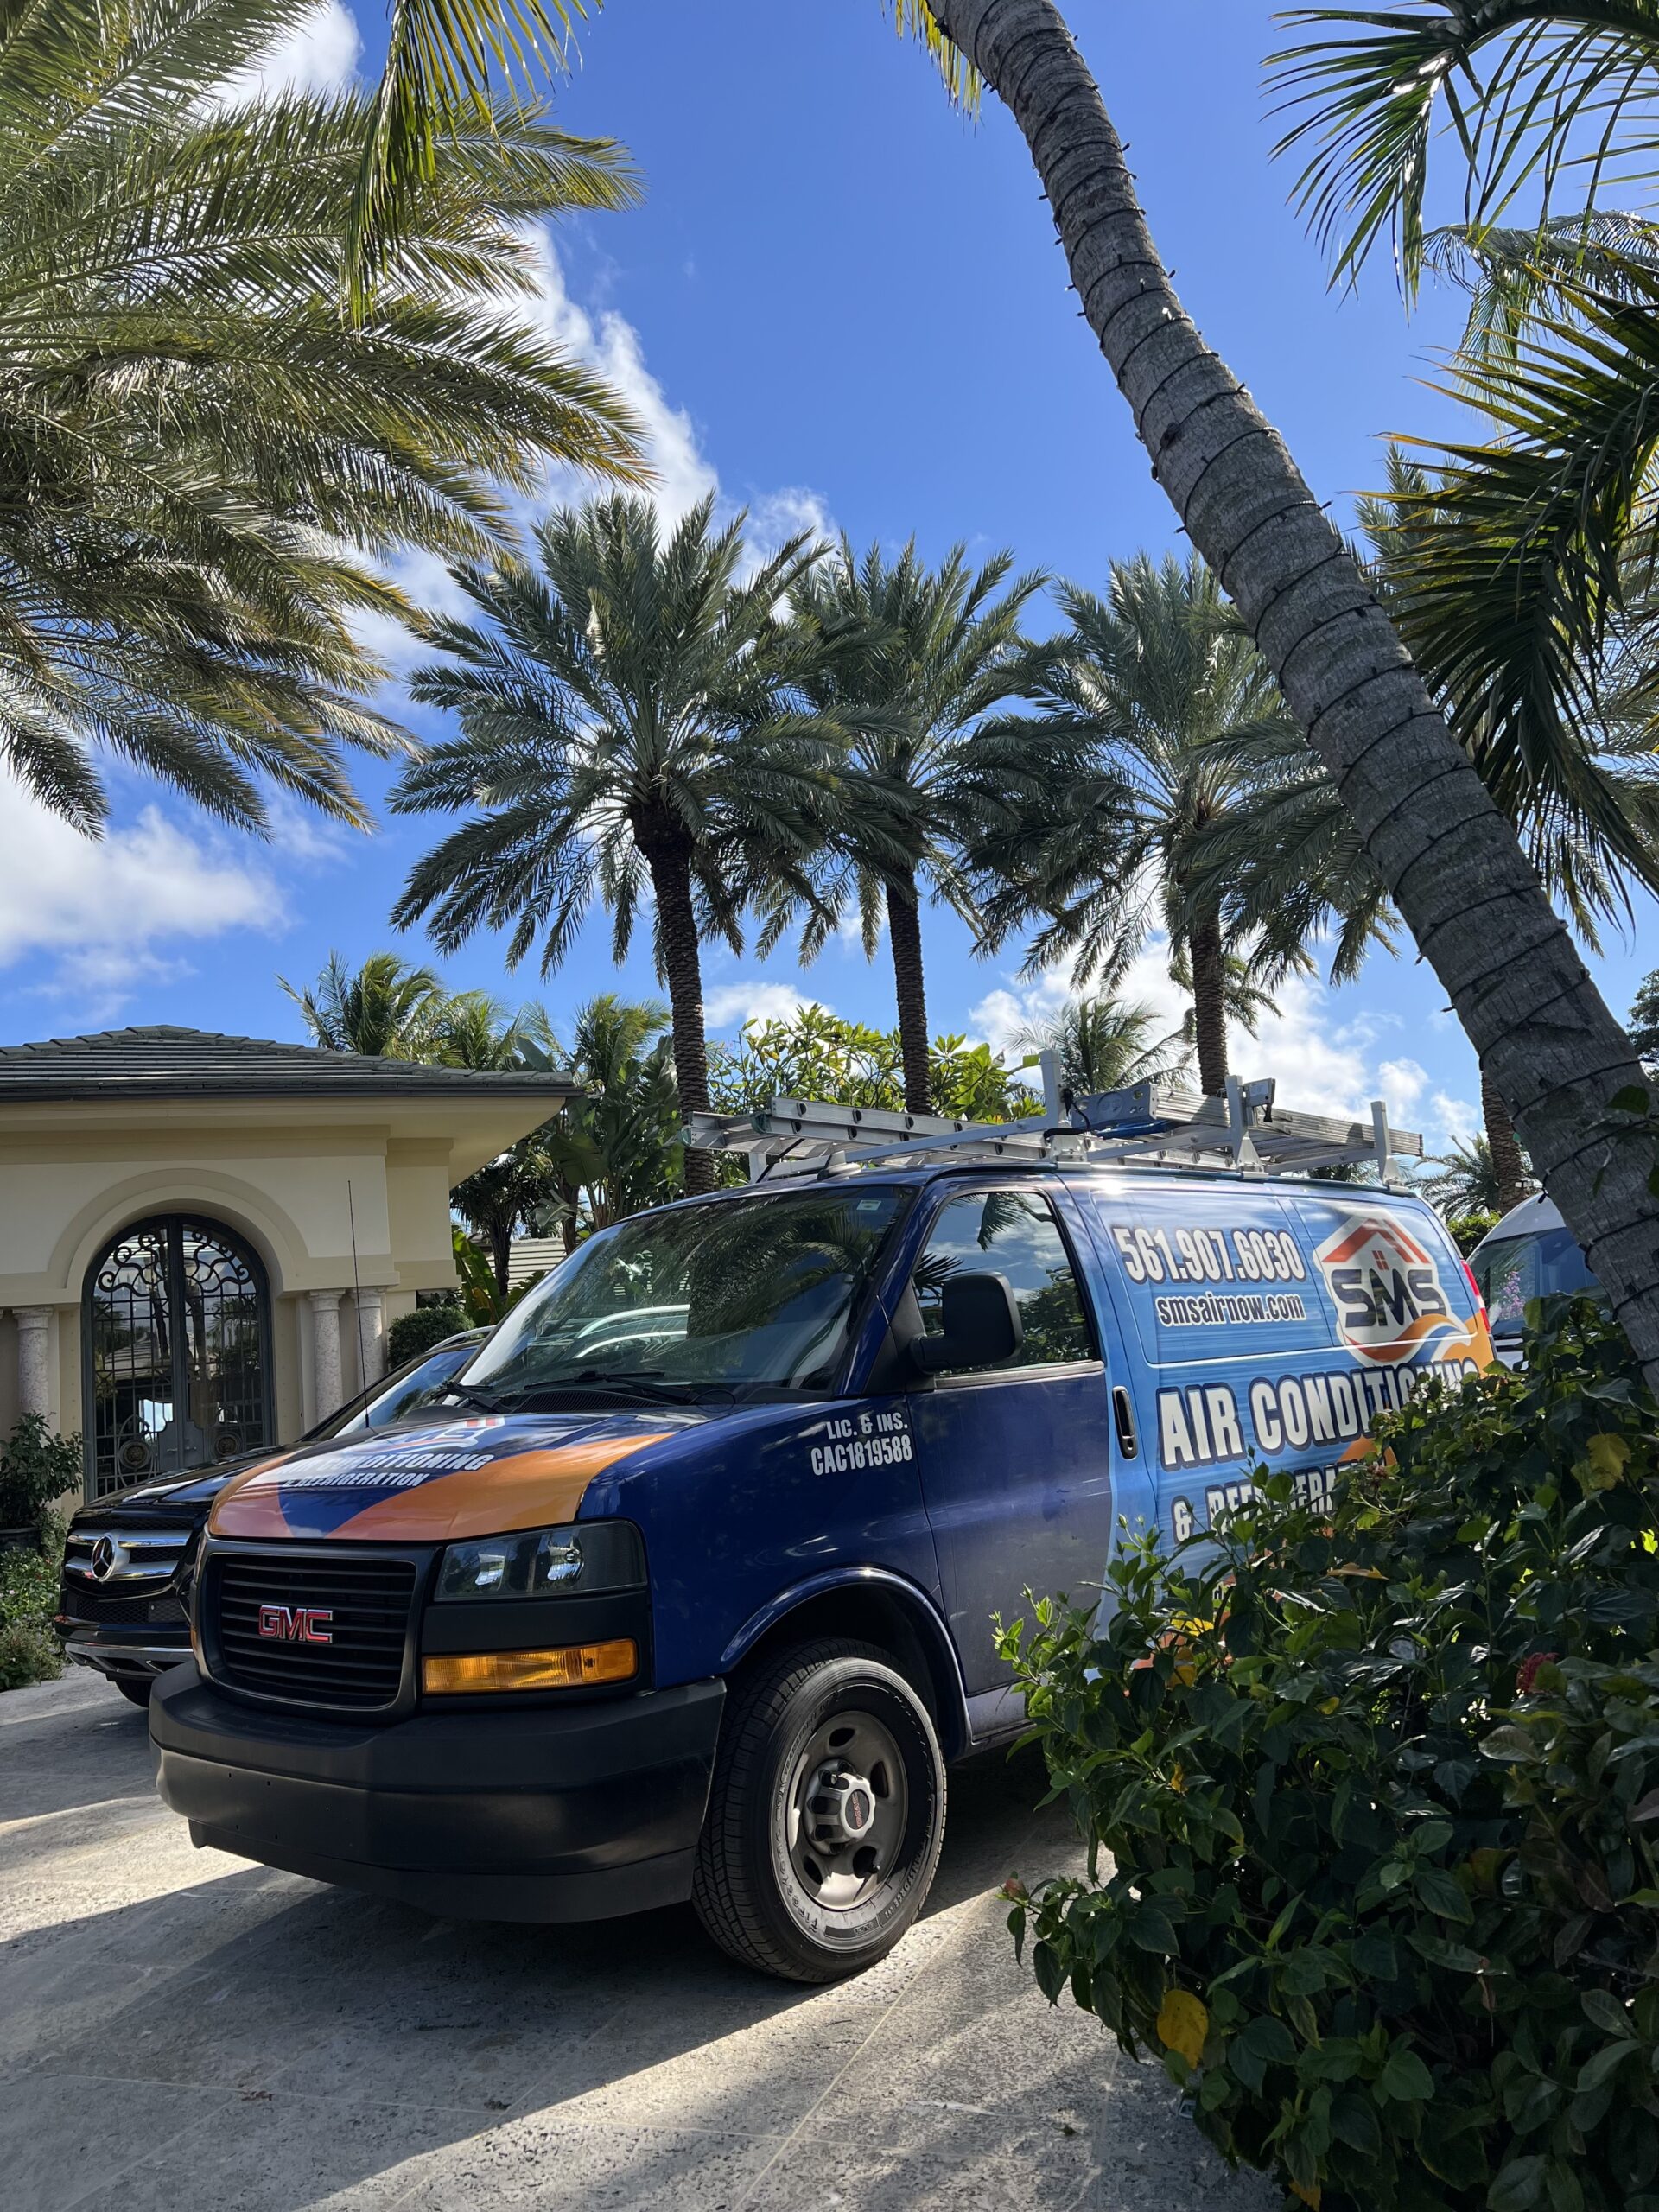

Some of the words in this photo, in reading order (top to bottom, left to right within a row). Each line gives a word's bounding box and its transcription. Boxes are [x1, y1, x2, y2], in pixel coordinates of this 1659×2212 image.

[1114, 1226, 1306, 1283] 561.907.6030
[1156, 1293, 1306, 1326] smsairnow.com
[1331, 1268, 1446, 1328] SMS
[827, 1419, 857, 1440] LIC.
[860, 1416, 873, 1435] &
[876, 1412, 908, 1433] INS.
[1157, 1386, 1244, 1467] AIR
[810, 1434, 912, 1476] CAC1819588
[296, 1473, 430, 1487] REFRIGERATION
[258, 1605, 333, 1643] GMC
